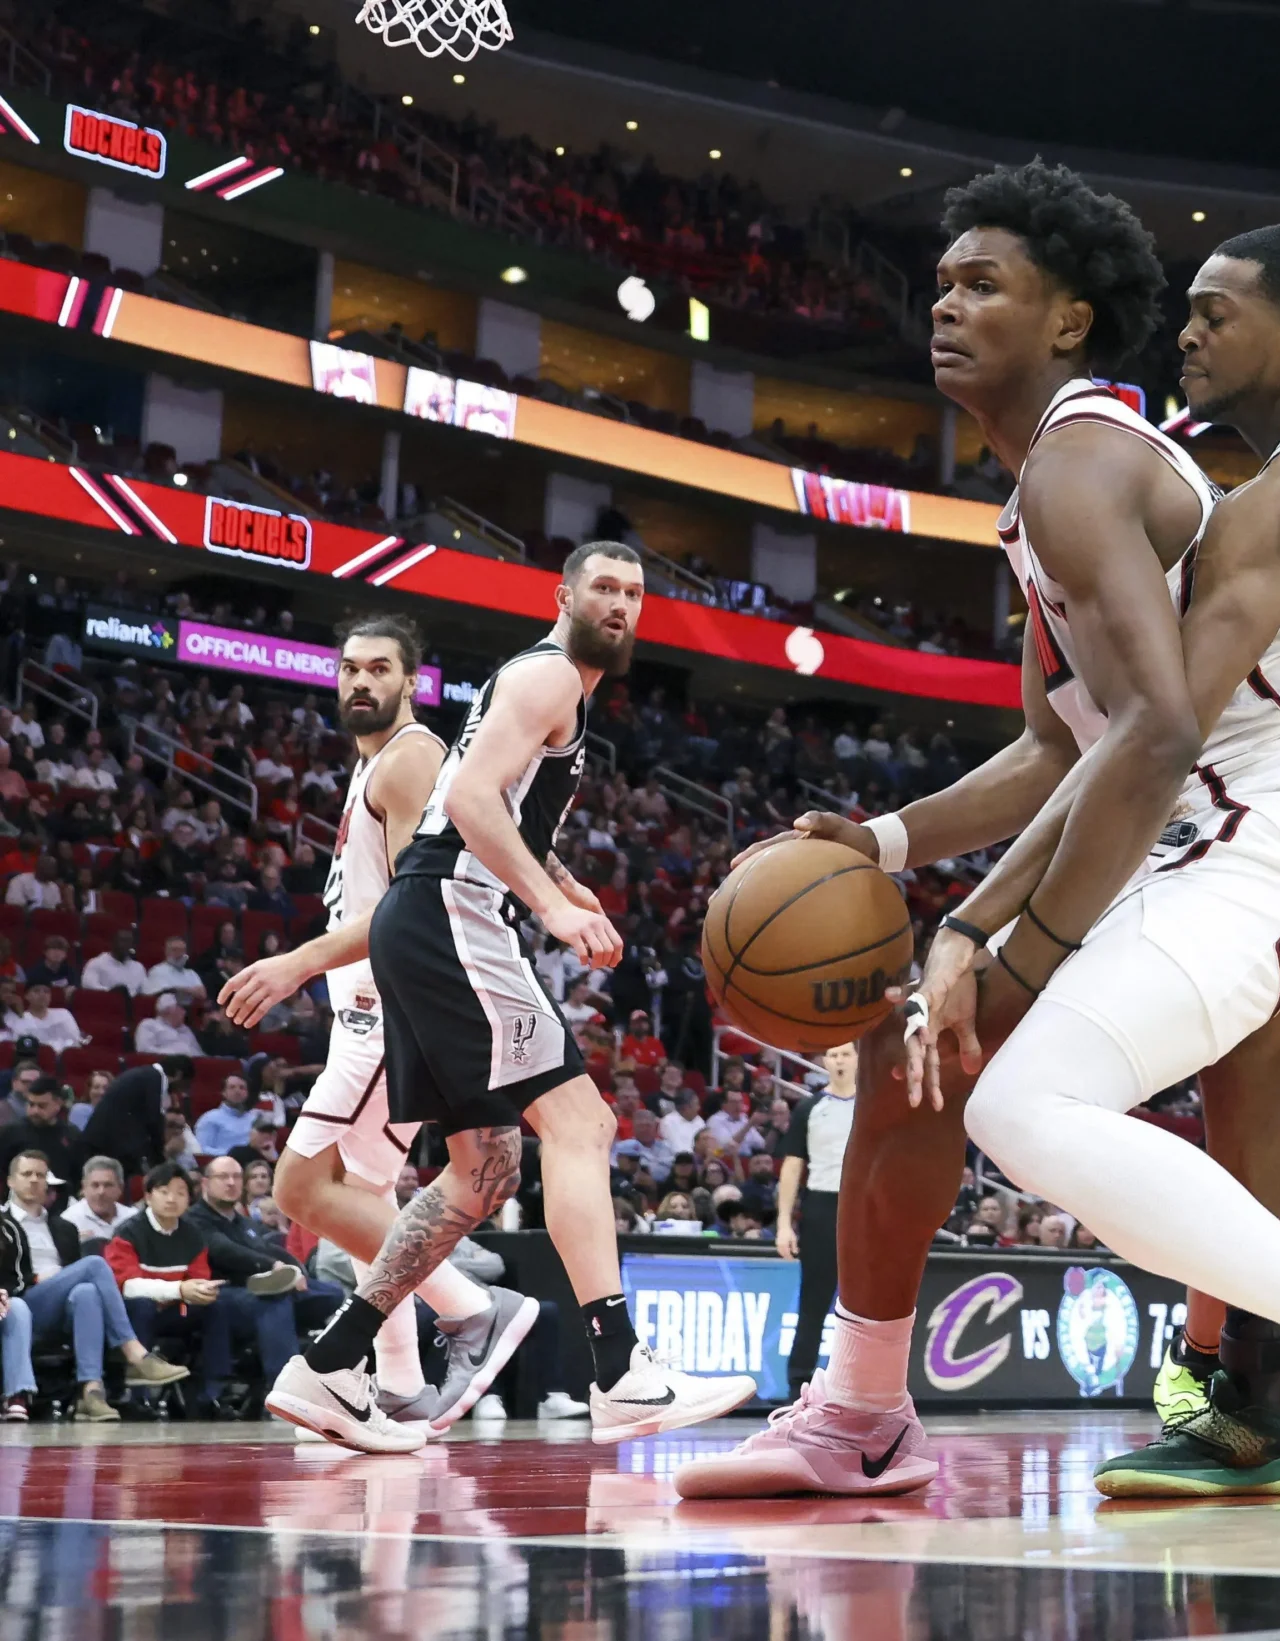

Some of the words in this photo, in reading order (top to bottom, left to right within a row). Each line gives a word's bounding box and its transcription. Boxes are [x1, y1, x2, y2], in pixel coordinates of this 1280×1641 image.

[86, 616, 152, 647] reliant
[185, 632, 272, 668] OFFICIAL
[274, 649, 338, 678] ENERG
[443, 681, 479, 703] reli
[809, 967, 905, 1013] Wil
[635, 1289, 771, 1372] FRIDAY
